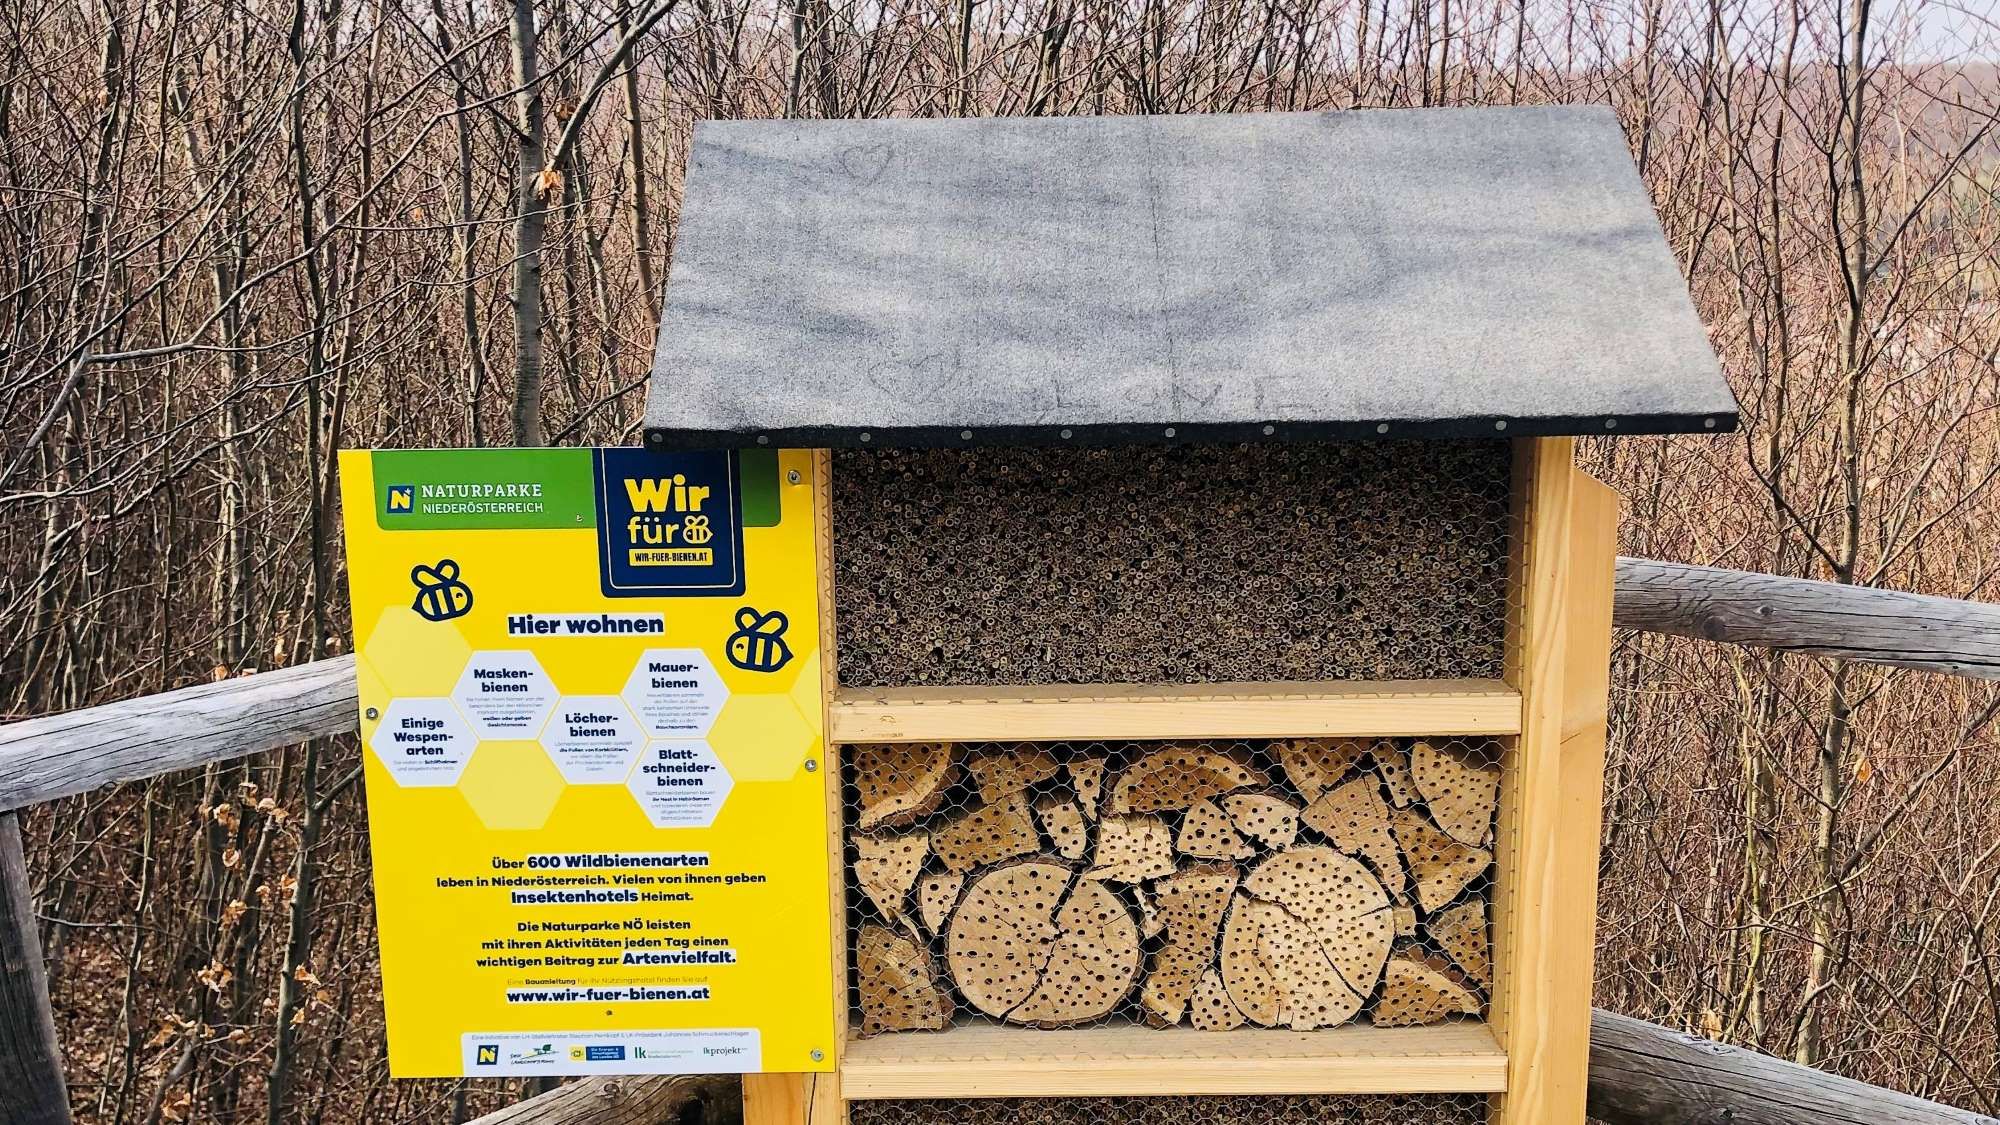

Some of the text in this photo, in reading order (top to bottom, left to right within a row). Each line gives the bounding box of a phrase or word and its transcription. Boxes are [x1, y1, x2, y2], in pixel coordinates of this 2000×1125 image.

[422, 484, 542, 498] NATURPARKE
[624, 474, 710, 513] Wir
[423, 501, 543, 514] NIEDERÖSTERREICH
[628, 516, 679, 544] für
[635, 552, 708, 562] WIR-FUER-BIENEN.AT
[508, 614, 664, 634] Hier wohnen
[474, 668, 533, 678] Masken-
[648, 662, 699, 673] Mauer-
[482, 681, 528, 692] bienen
[651, 677, 698, 688] bienen
[401, 717, 444, 730] Einige
[565, 713, 619, 723] Löcher-
[393, 732, 454, 743] Wespen-
[569, 726, 616, 737] bienen
[406, 746, 444, 755] arten
[659, 749, 698, 759] Blatt-
[642, 762, 716, 773] schneider-
[657, 775, 703, 786] bienen
[492, 854, 709, 868] Über 600 Wildbienenarten
[436, 873, 766, 887] leben in Niederösterreich. Vielen von ihnen geben
[511, 889, 694, 903] Insektenhotels Heimat.
[517, 918, 691, 932] Die Naturparke NÖ leisten
[481, 936, 729, 949] mit ihren Aktivitäten jeden Tag einen
[476, 951, 736, 968] wichtigen Beitrag zur Artenvielfalt.
[507, 987, 710, 1002] www.wir-fuer-bienen.at
[634, 1047, 647, 1059] lk
